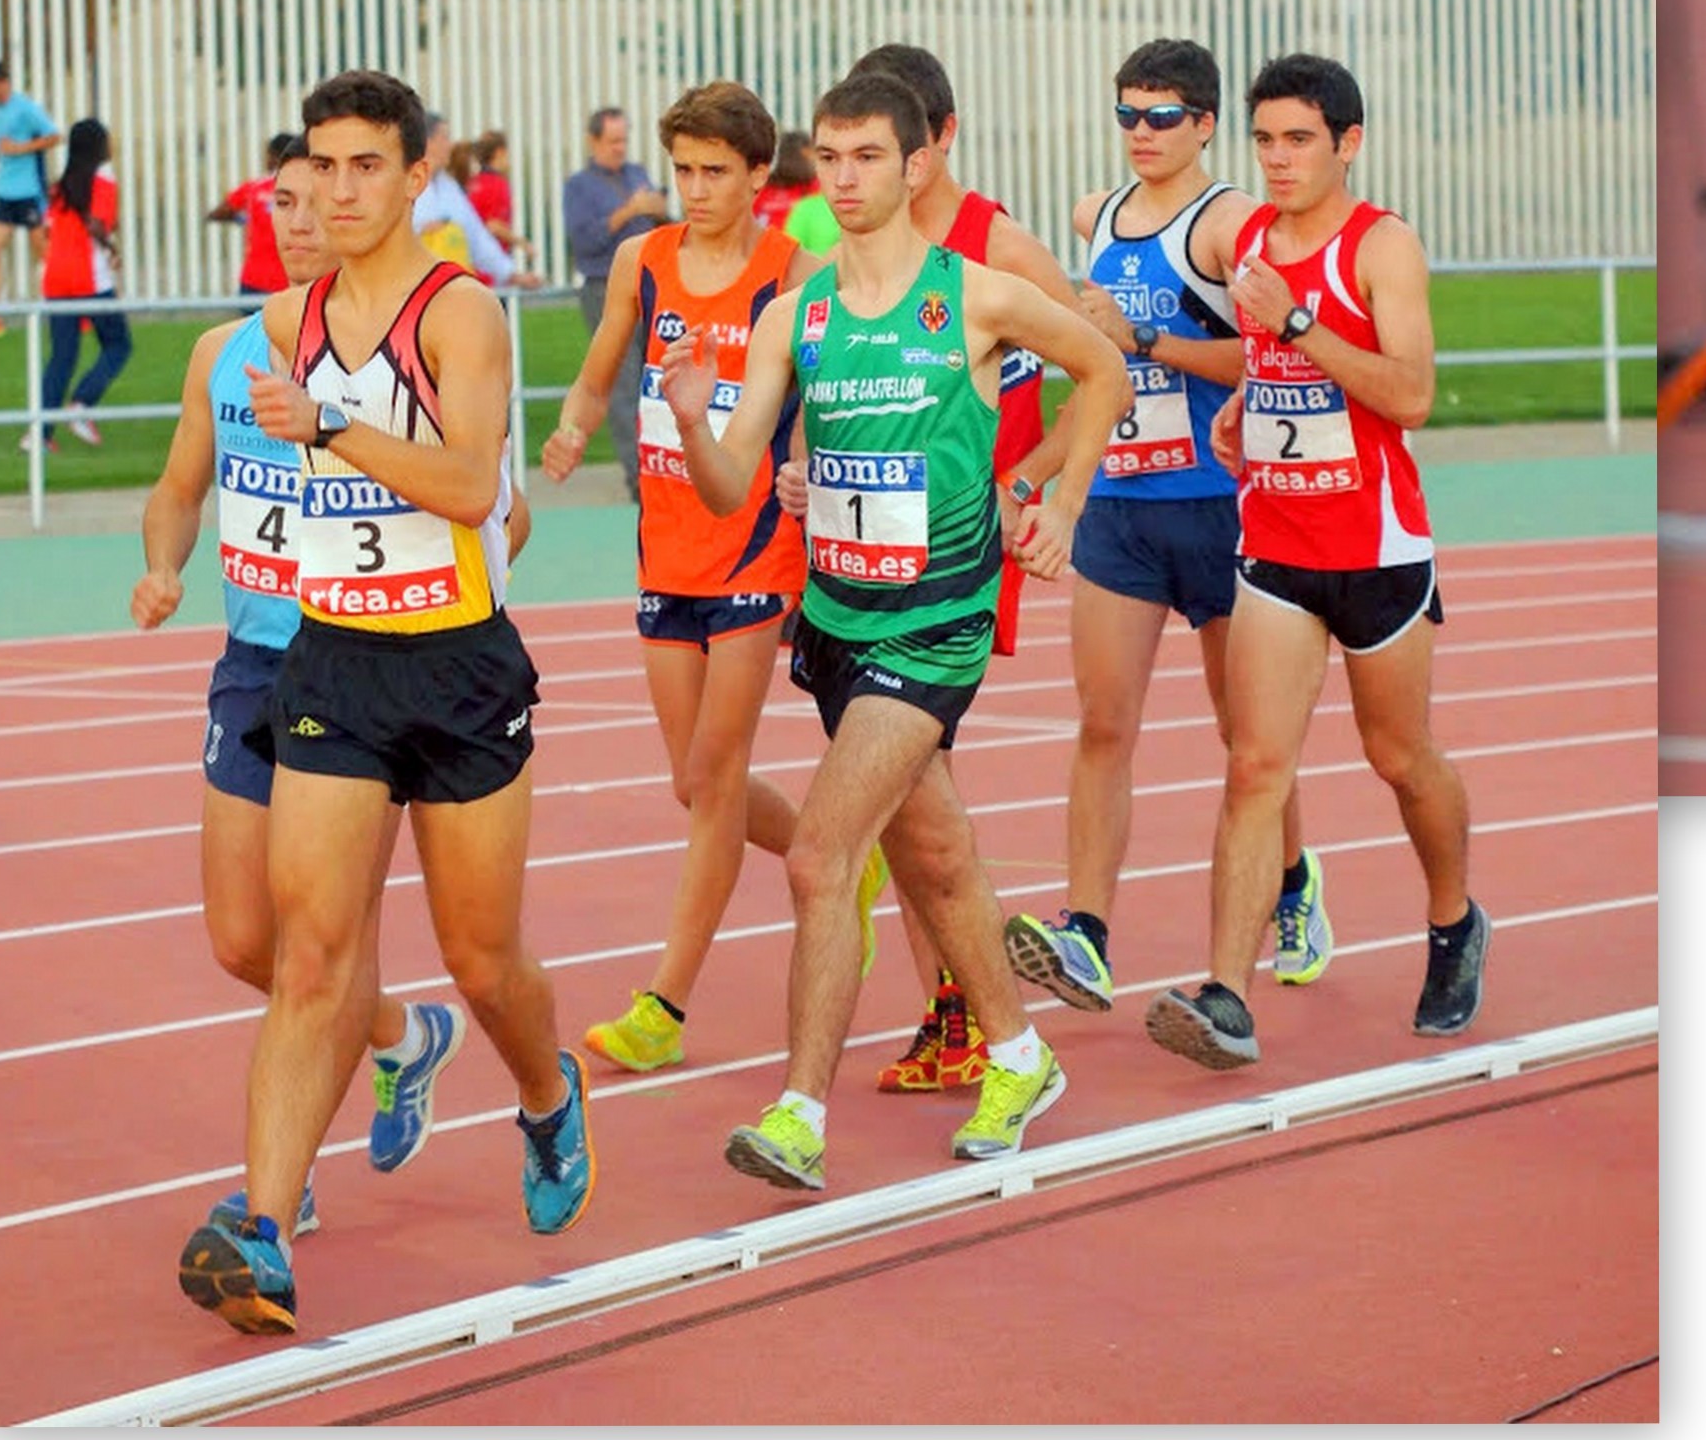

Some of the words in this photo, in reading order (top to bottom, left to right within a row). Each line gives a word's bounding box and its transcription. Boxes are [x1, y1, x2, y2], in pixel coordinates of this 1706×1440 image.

[840, 377, 859, 402] DE
[1275, 418, 1304, 460] 2
[225, 459, 301, 497] Jom
[1105, 447, 1187, 473] ea.es
[1251, 465, 1352, 491] rfea.es
[256, 506, 288, 554] 4
[847, 493, 862, 540] 1
[352, 520, 386, 574] 3
[818, 542, 917, 579] rfea.es
[223, 553, 299, 593] rfea.
[309, 578, 450, 614] rfea.es
